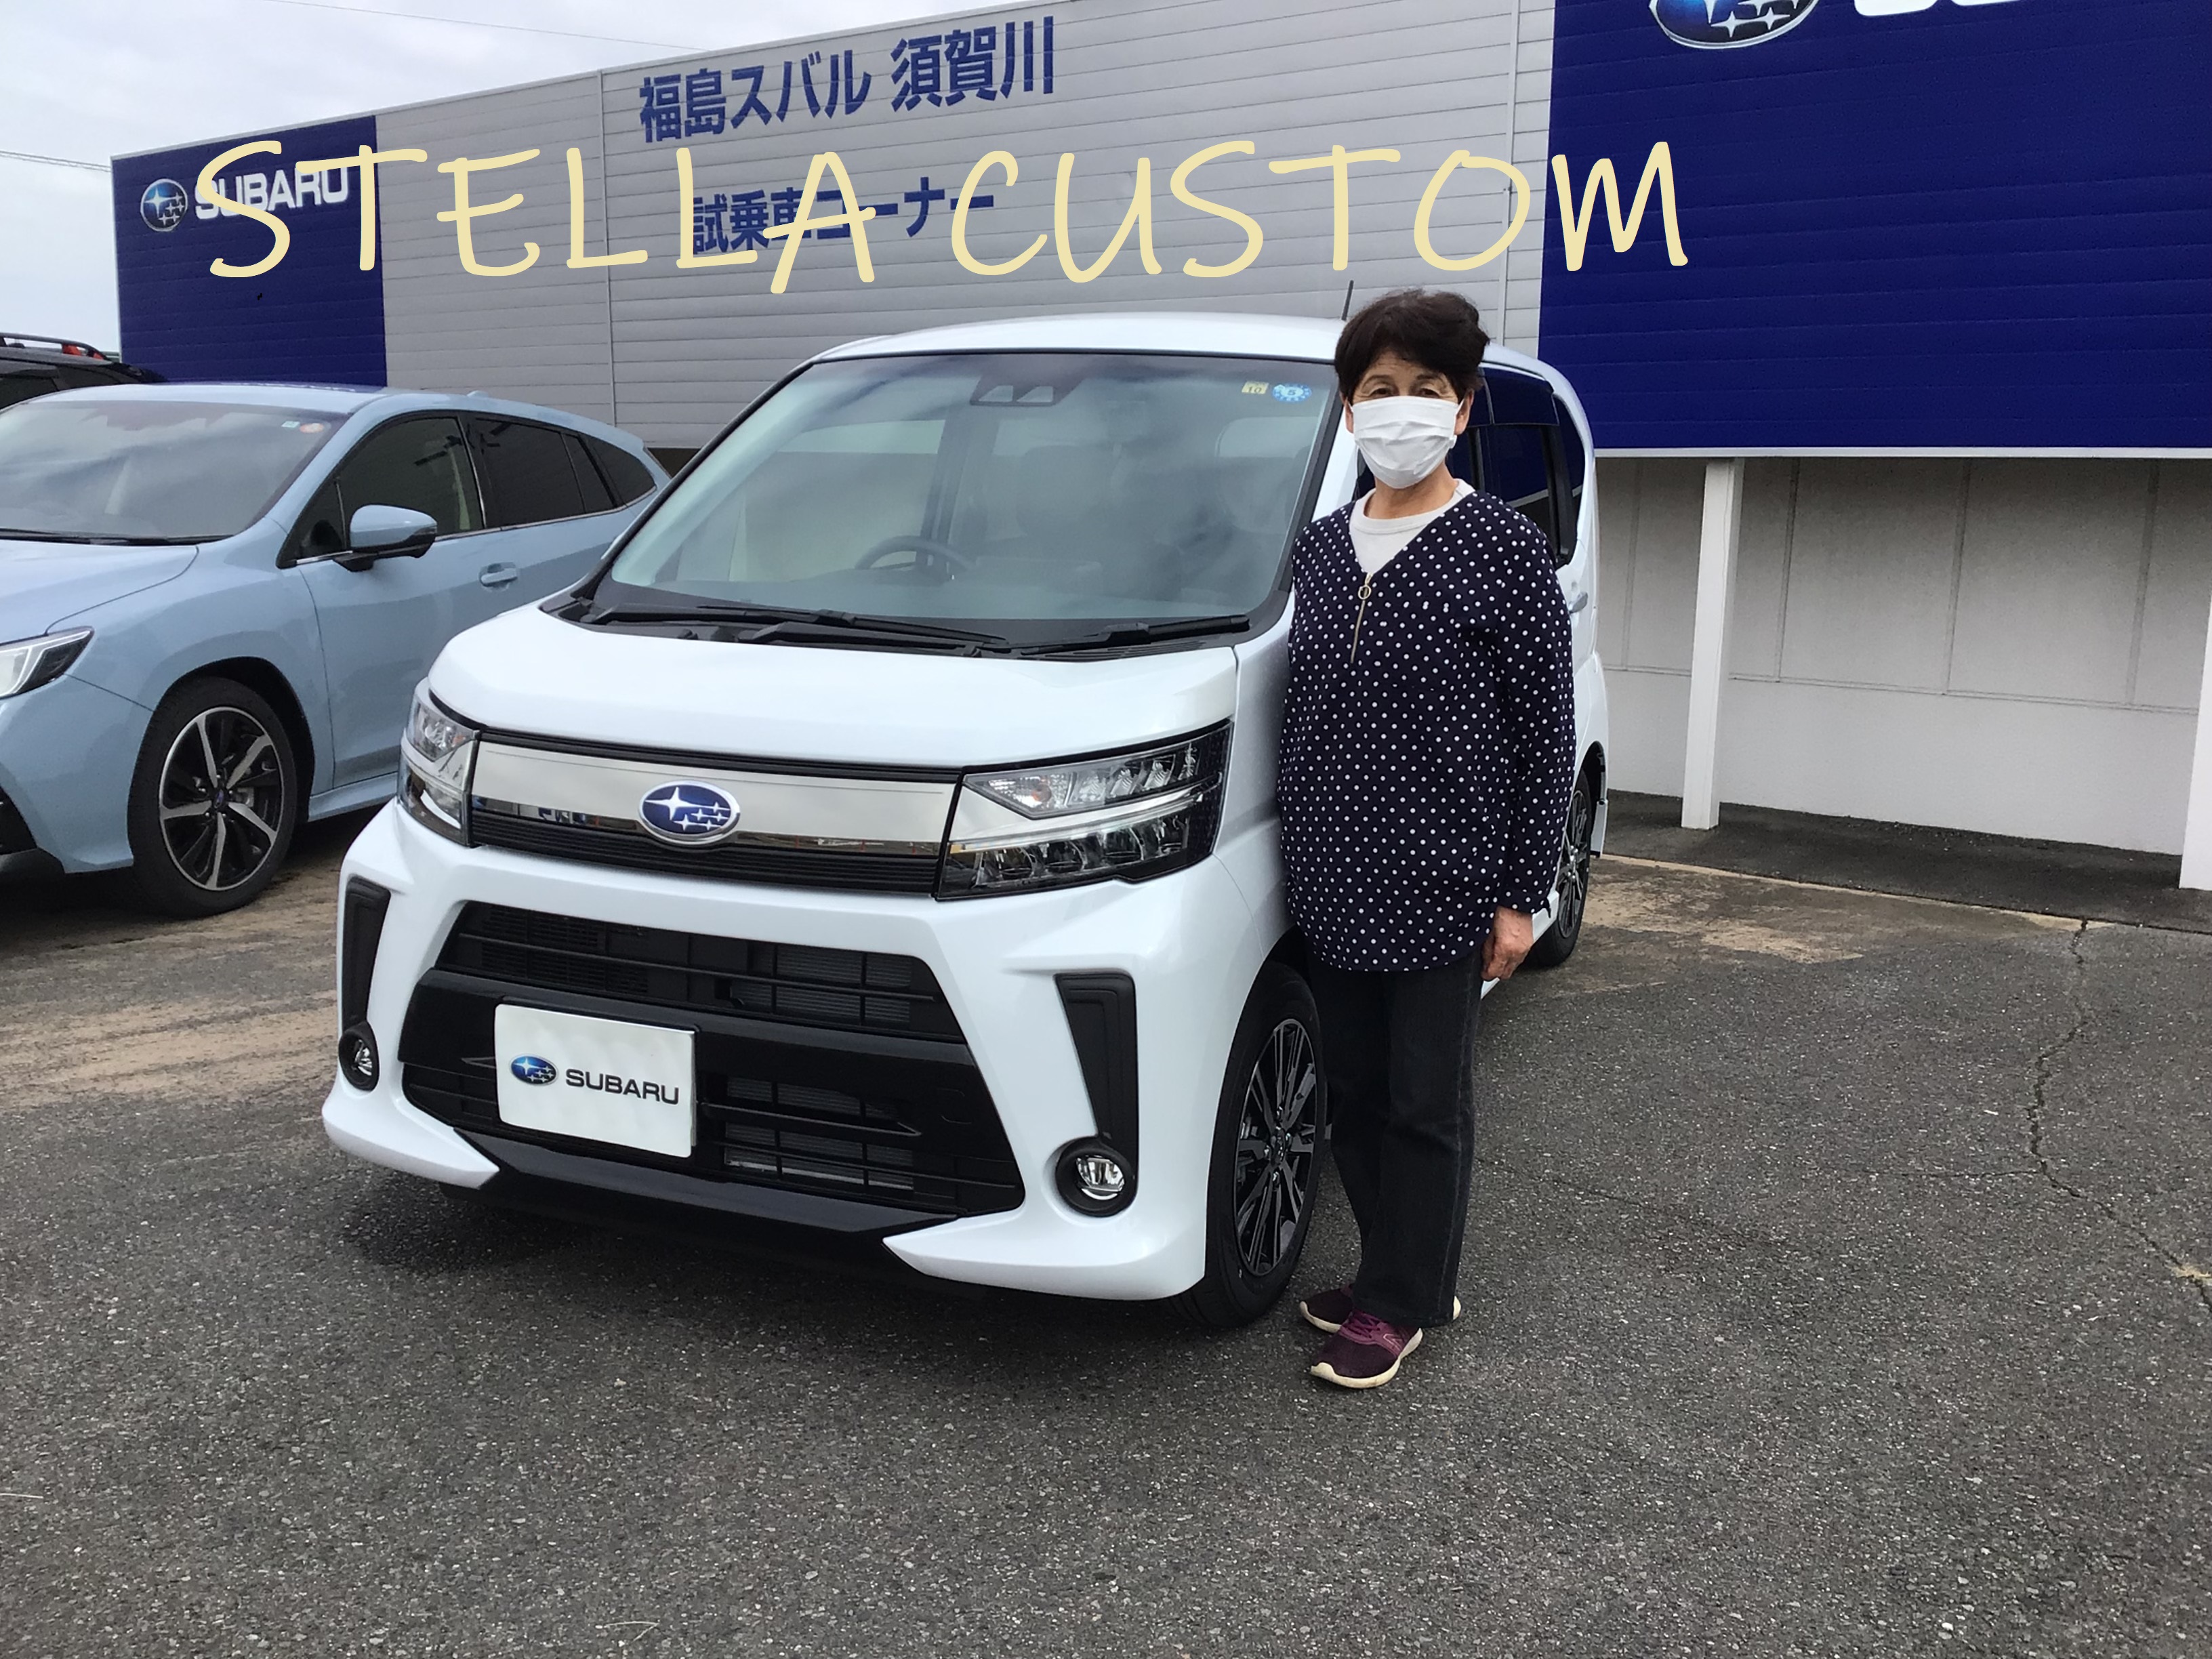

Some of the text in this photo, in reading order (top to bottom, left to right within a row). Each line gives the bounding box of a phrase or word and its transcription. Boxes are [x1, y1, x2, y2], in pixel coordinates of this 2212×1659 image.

[639, 16, 1054, 143] 福島スバル 須賀川
[194, 164, 349, 220] SUBARU
[565, 1068, 679, 1105] SUBARU
